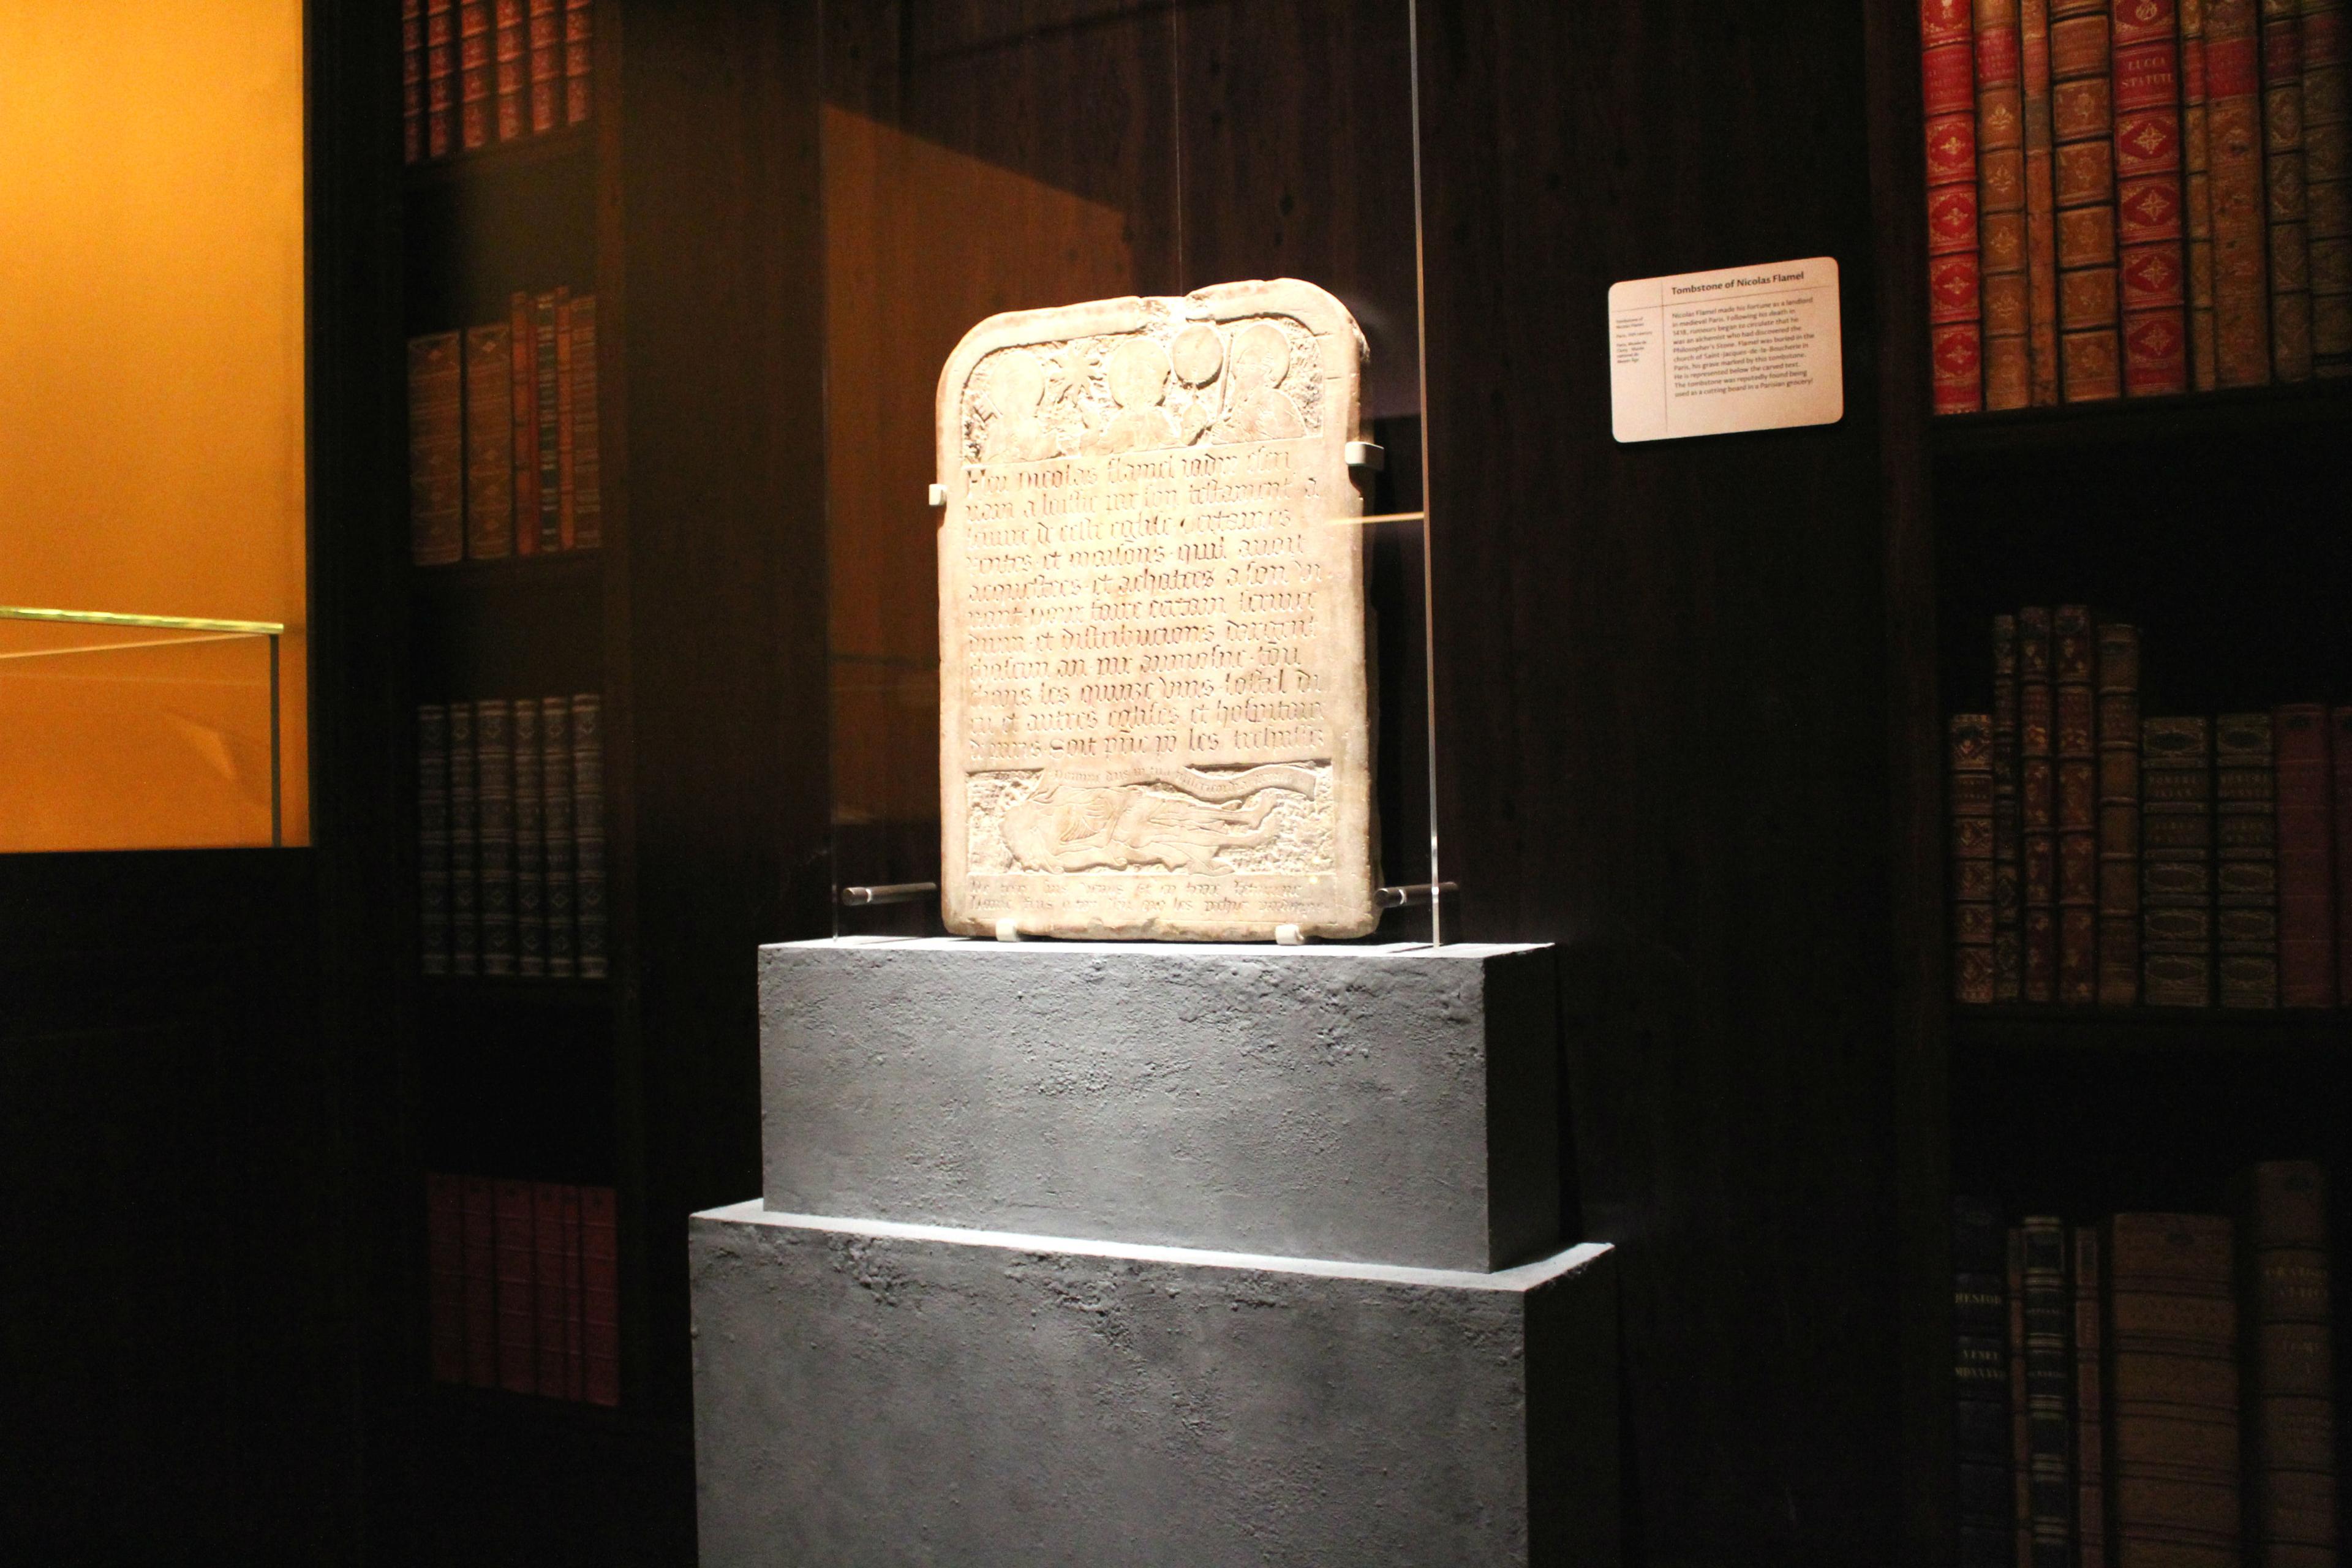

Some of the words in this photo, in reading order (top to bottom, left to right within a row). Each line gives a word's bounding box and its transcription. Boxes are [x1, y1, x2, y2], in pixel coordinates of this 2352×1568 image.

[1672, 282, 1723, 295] Tombstone
[1725, 280, 1735, 288] of
[1737, 276, 1771, 287] Nicolas
[1773, 271, 1804, 282] Flamel
[1747, 301, 1771, 311] fortune
[1786, 297, 1814, 306] landlord
[1679, 318, 1707, 327] medieval
[1727, 312, 1757, 322] Following
[1718, 324, 1737, 333] began
[1747, 319, 1774, 329] circulate
[1695, 334, 1725, 342] alchemist
[1755, 327, 1790, 336] discovered
[1774, 334, 1795, 343] buried
[1673, 353, 1695, 362] church
[1768, 352, 1807, 361] tombstone.
[1687, 377, 1722, 387] tombstone
[1737, 373, 1768, 383] reputedly
[1769, 371, 1788, 379] found
[1789, 369, 1807, 378] being
[1690, 368, 1728, 378] represented
[1703, 386, 1727, 394] cutting
[1728, 383, 1746, 391] board
